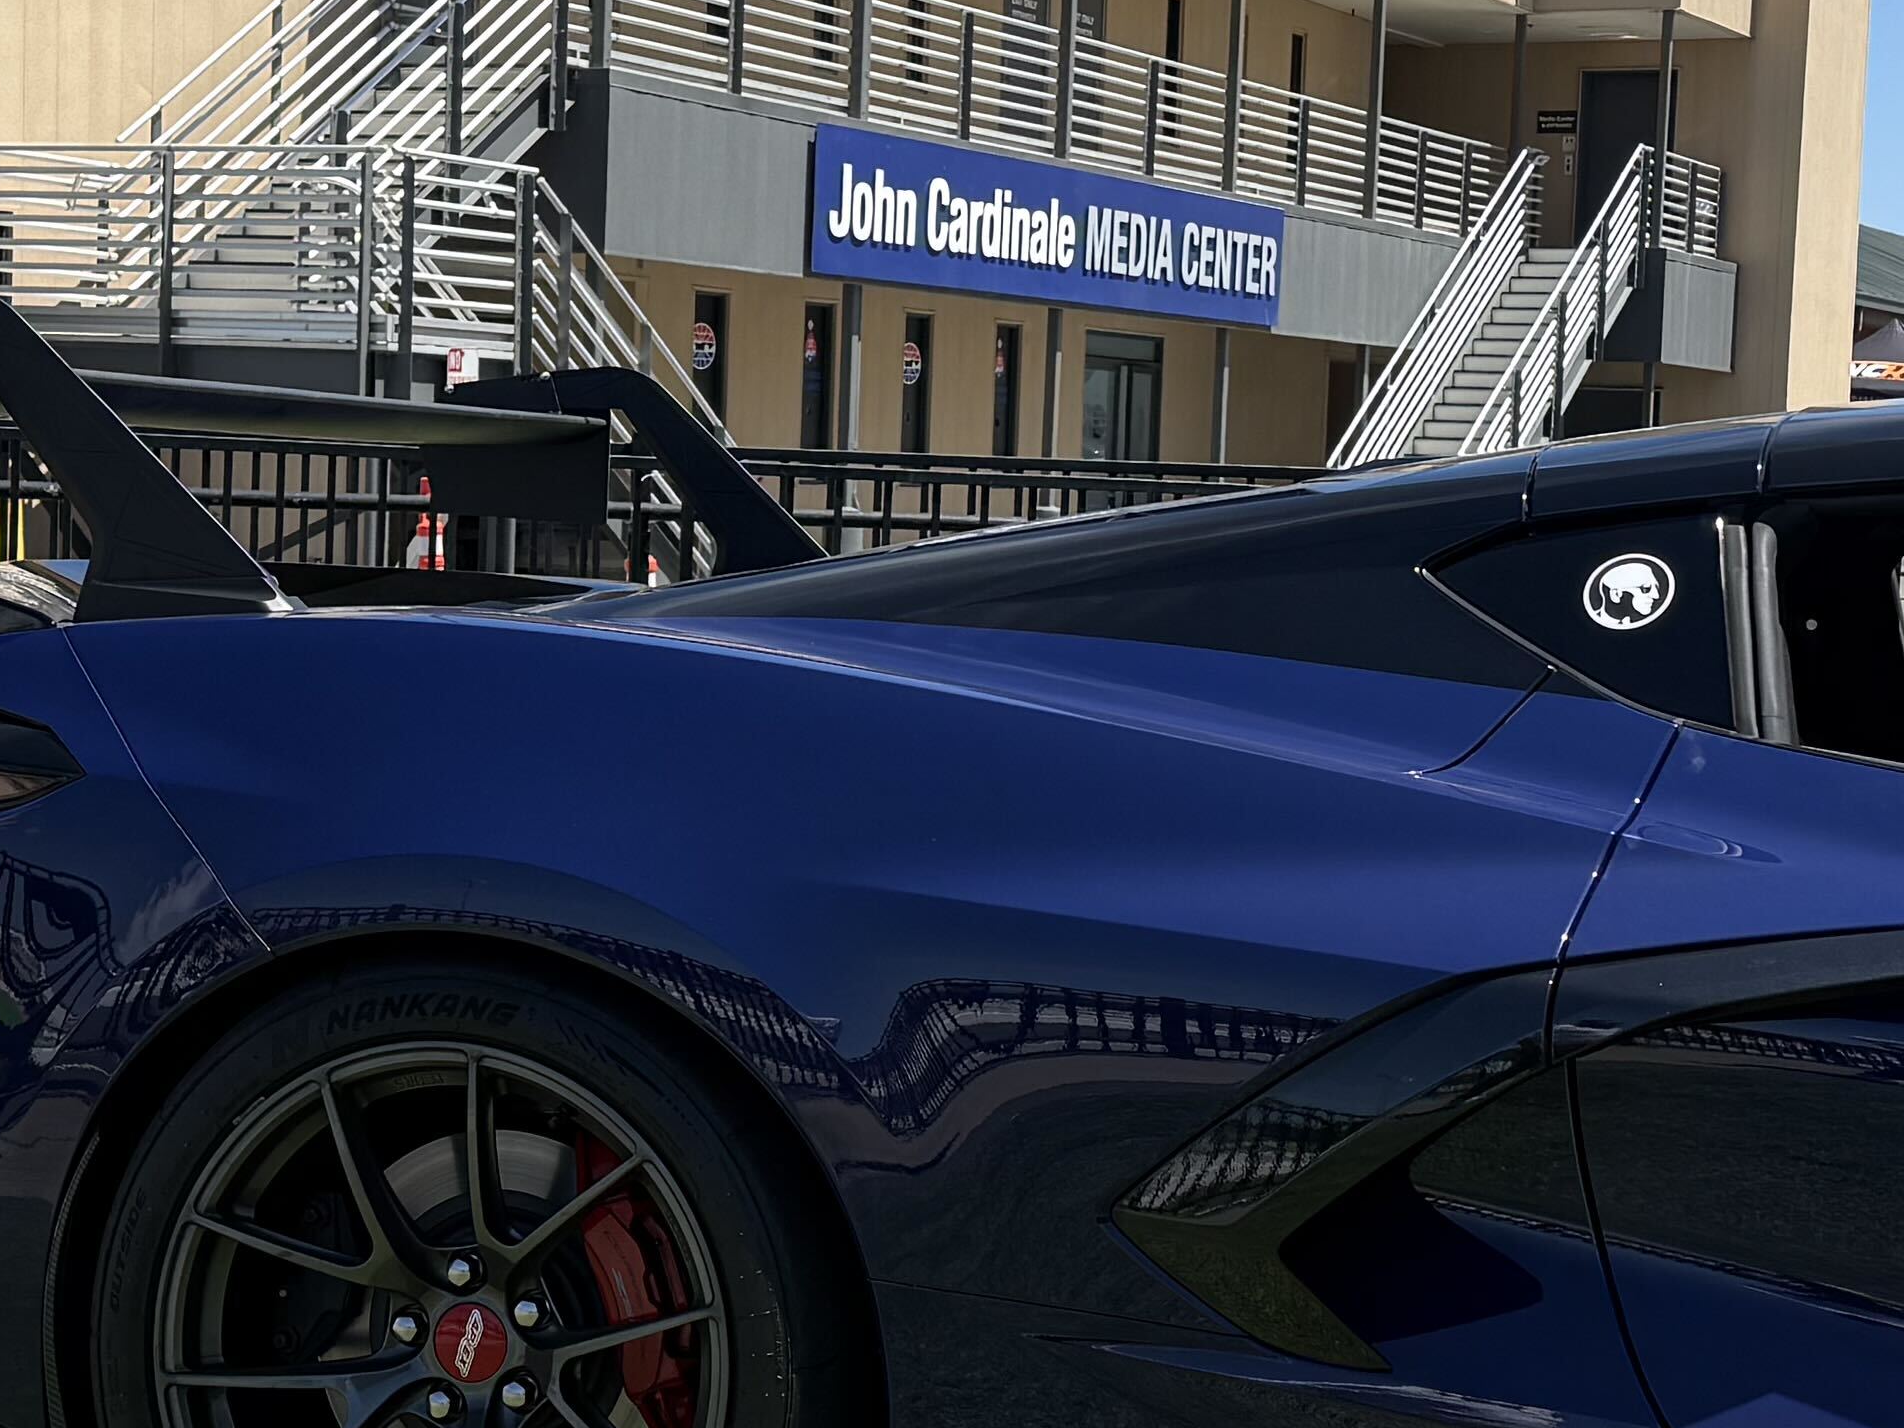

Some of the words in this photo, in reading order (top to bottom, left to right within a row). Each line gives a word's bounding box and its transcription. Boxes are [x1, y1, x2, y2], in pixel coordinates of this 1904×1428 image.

[829, 162, 917, 247] John
[927, 177, 1076, 268] Cardinale
[1084, 205, 1174, 283] MEDIA
[1181, 222, 1278, 296] CENTER
[326, 992, 521, 1035] NANKANG
[110, 1188, 147, 1314] OUTSIDE
